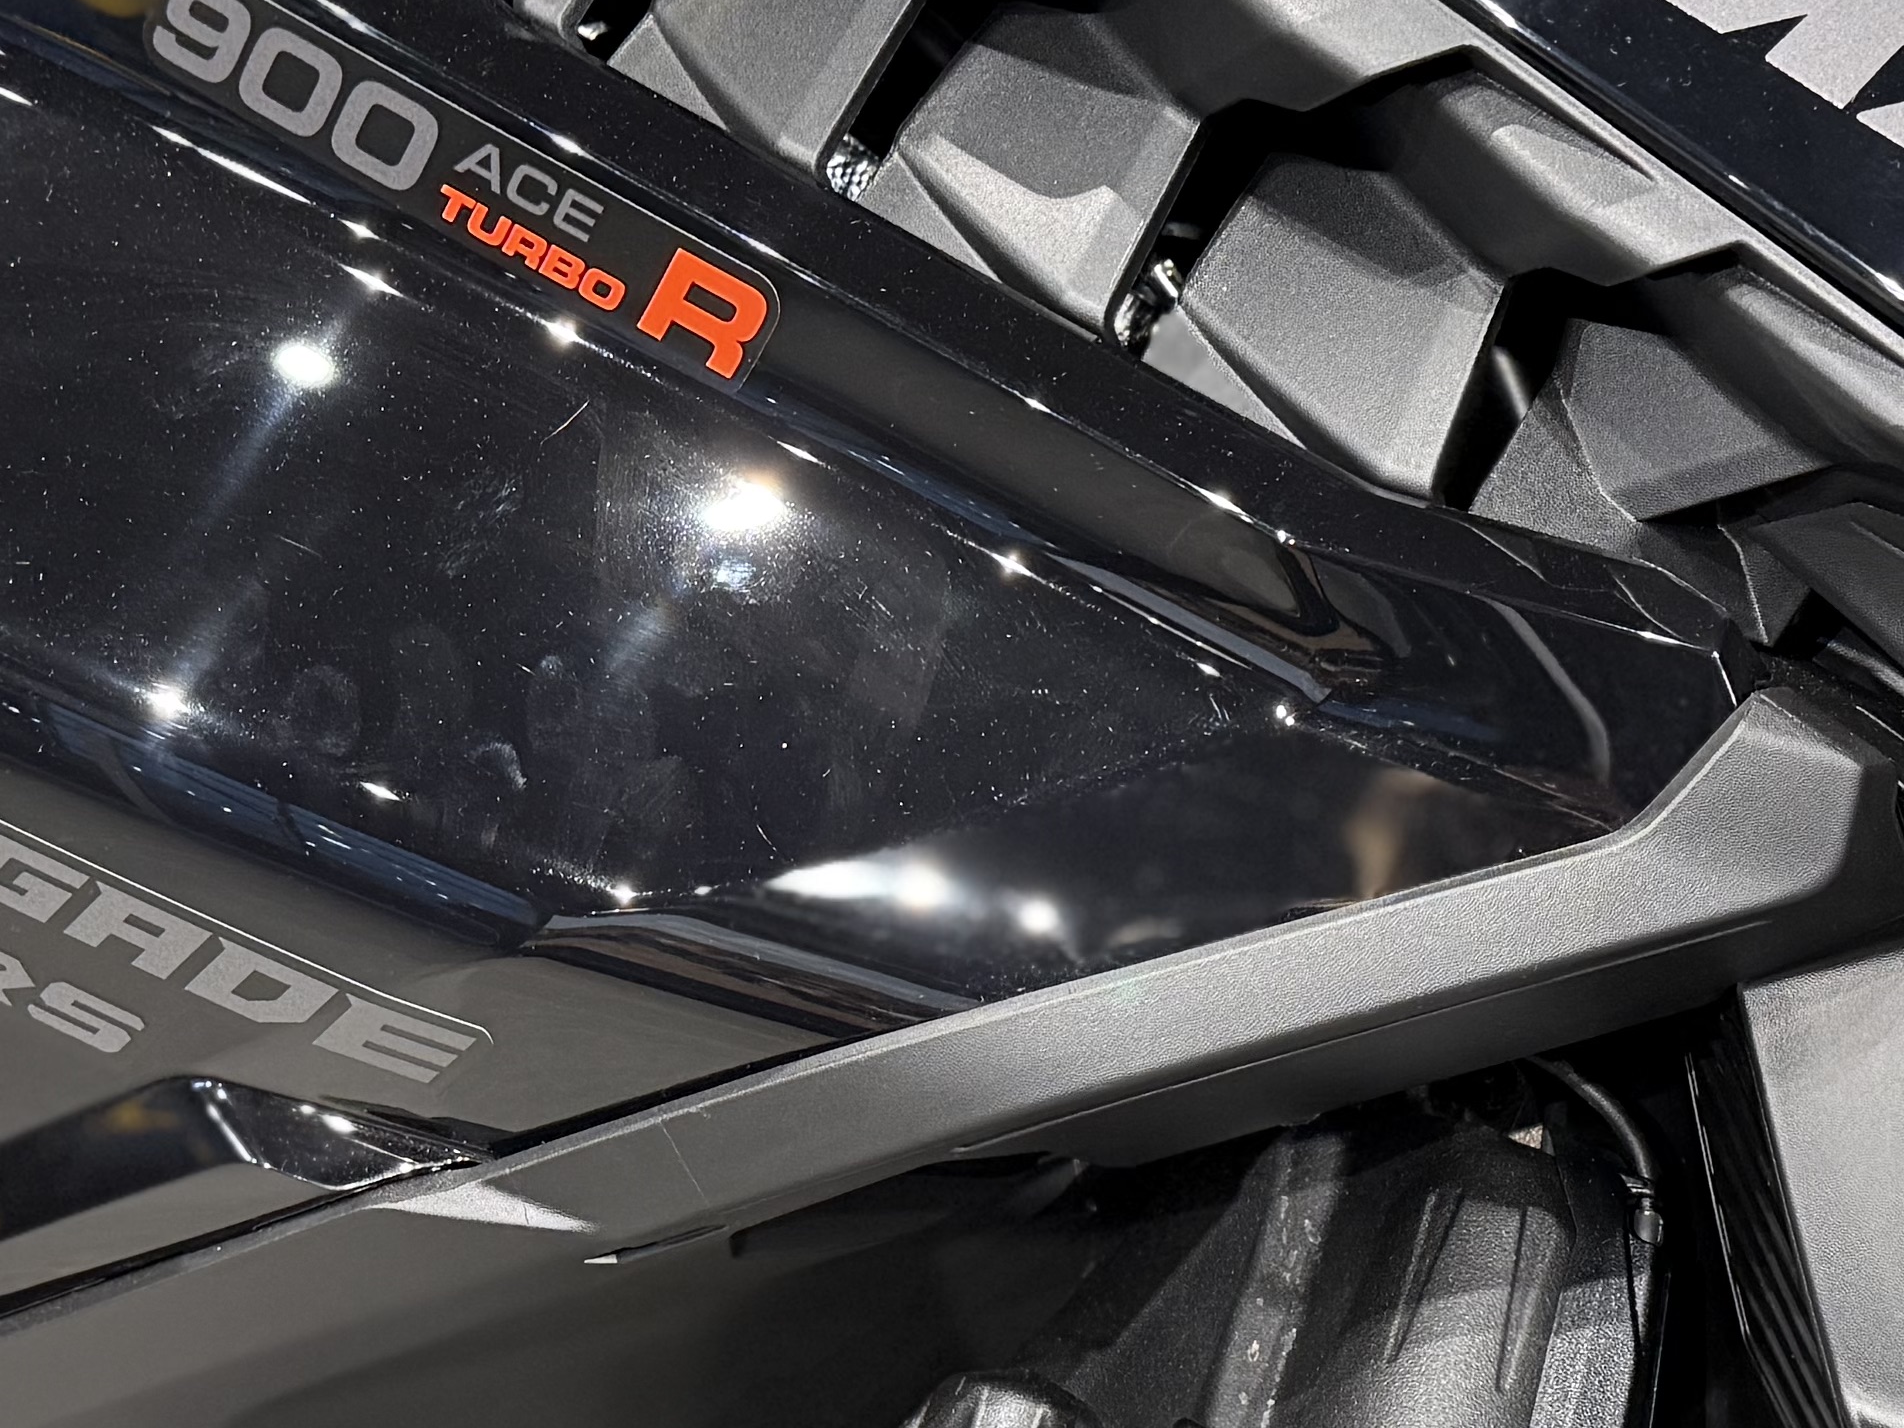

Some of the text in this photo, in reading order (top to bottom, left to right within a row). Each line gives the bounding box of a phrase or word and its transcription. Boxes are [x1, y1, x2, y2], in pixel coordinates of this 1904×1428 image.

[454, 143, 604, 242] ACE
[440, 184, 767, 379] TURBO R
